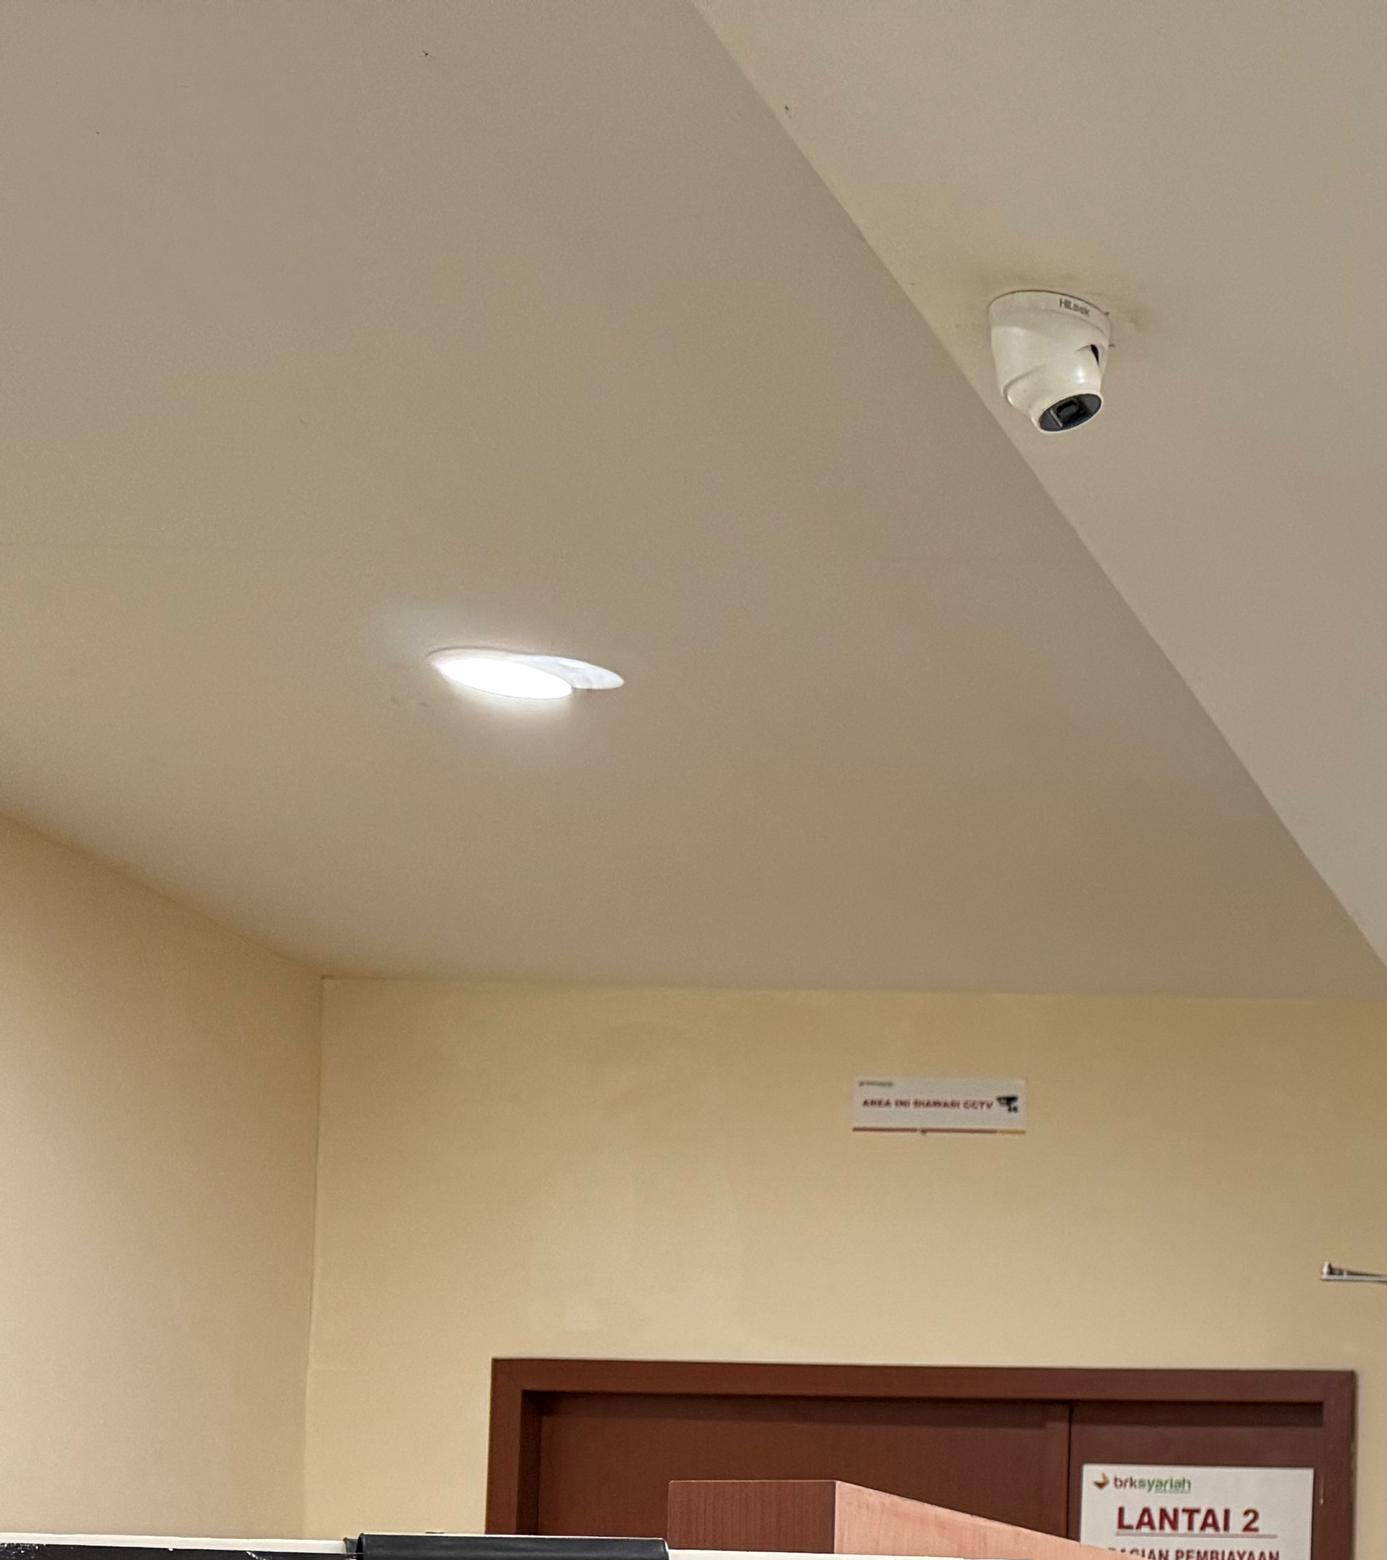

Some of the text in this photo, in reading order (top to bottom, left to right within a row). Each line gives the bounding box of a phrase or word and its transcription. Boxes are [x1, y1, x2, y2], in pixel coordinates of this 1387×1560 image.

[862, 1099, 891, 1108] AREA
[963, 1100, 994, 1110] CCTV
[1113, 1475, 1192, 1492] brksyariah
[1117, 1506, 1260, 1533] LANTAI 2
